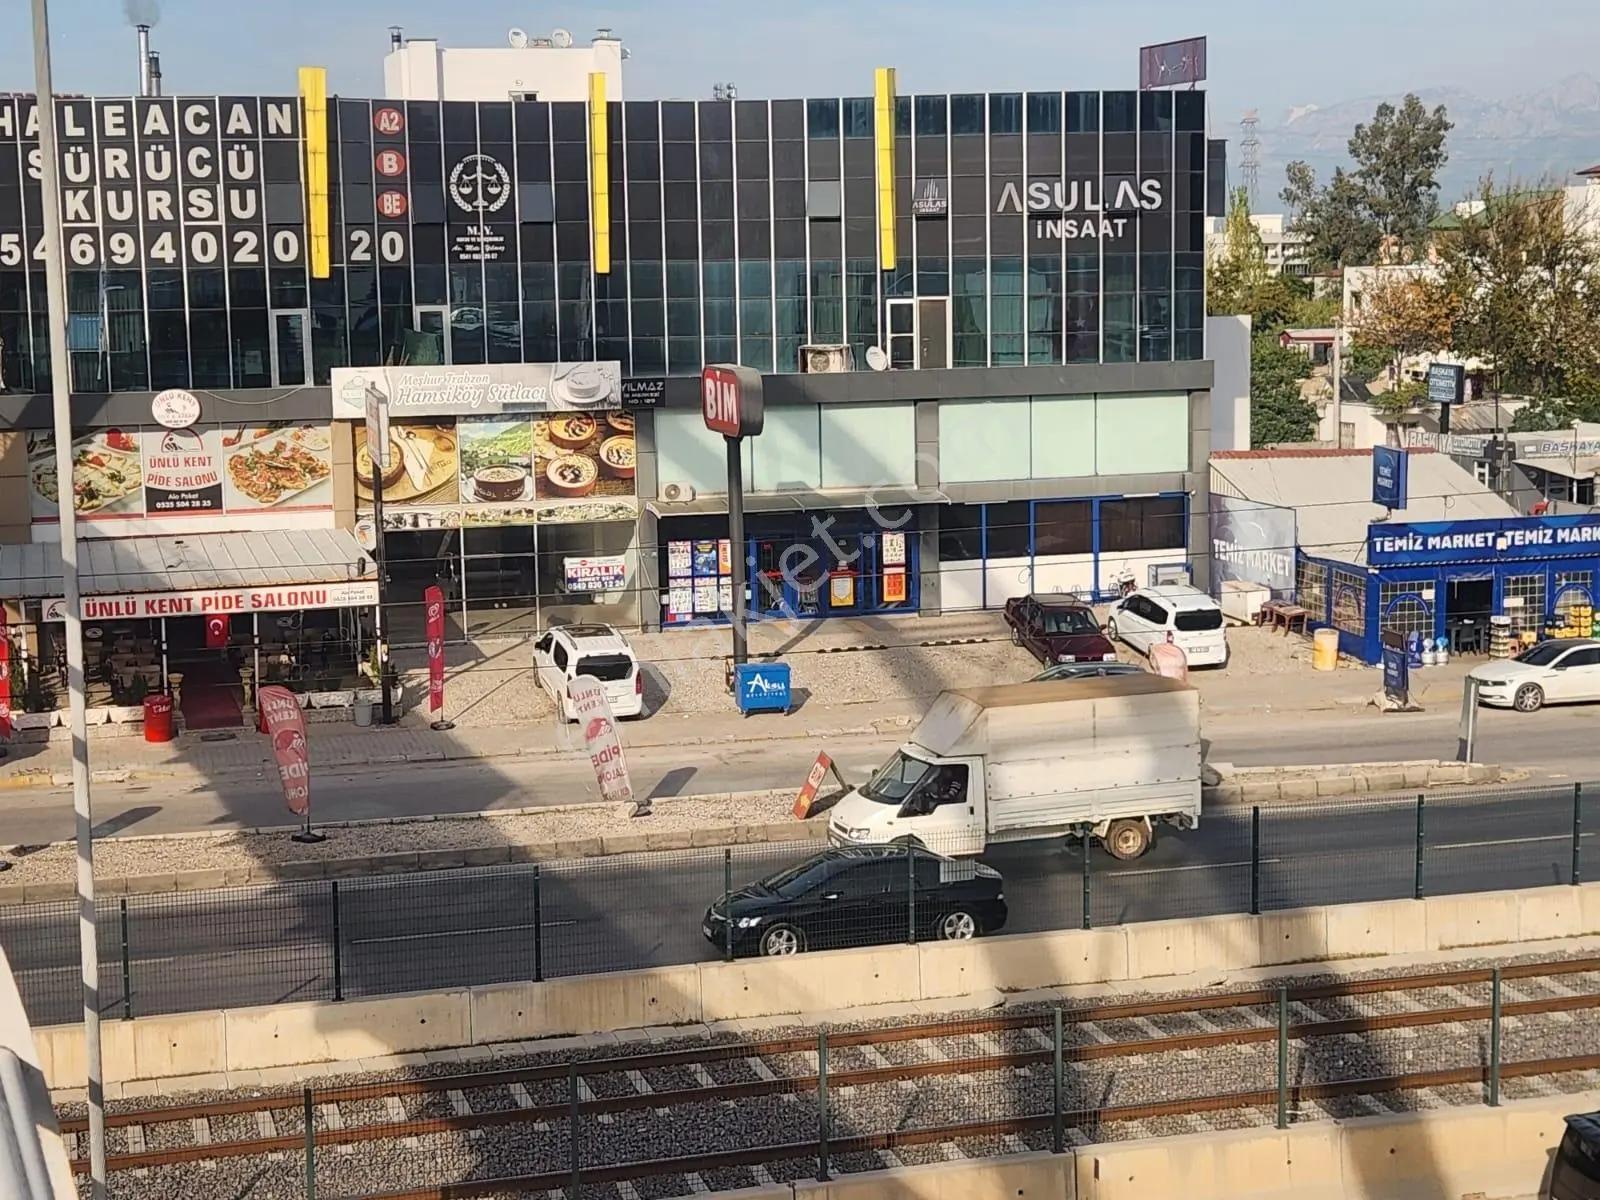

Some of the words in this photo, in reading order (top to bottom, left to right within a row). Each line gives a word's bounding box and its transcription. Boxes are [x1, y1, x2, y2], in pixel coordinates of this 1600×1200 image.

[379, 111, 400, 132] A2
[27, 144, 256, 184] SÜRÜCÜ
[382, 152, 399, 174] B
[64, 187, 258, 222] KURSU
[383, 193, 401, 215] BE
[402, 373, 445, 387] Meşhur
[445, 371, 490, 384] Trabzon
[397, 385, 484, 408] Hamsiköy
[487, 382, 547, 402] Sütlacı
[149, 455, 180, 469] ÜNLÜ
[184, 456, 213, 468] KENT
[146, 472, 172, 487] PİDE
[174, 471, 218, 487] SALONU
[1373, 531, 1424, 553] TEMİZ
[1427, 531, 1496, 550] MARKET
[1504, 526, 1553, 545] TEMİZ
[1213, 537, 1244, 565] TEMİZ
[1245, 551, 1293, 577] MARKET
[84, 596, 137, 618] ÜNLÜ
[144, 597, 194, 615] KENT
[201, 591, 245, 612] PİDE
[251, 590, 327, 609] SALONU
